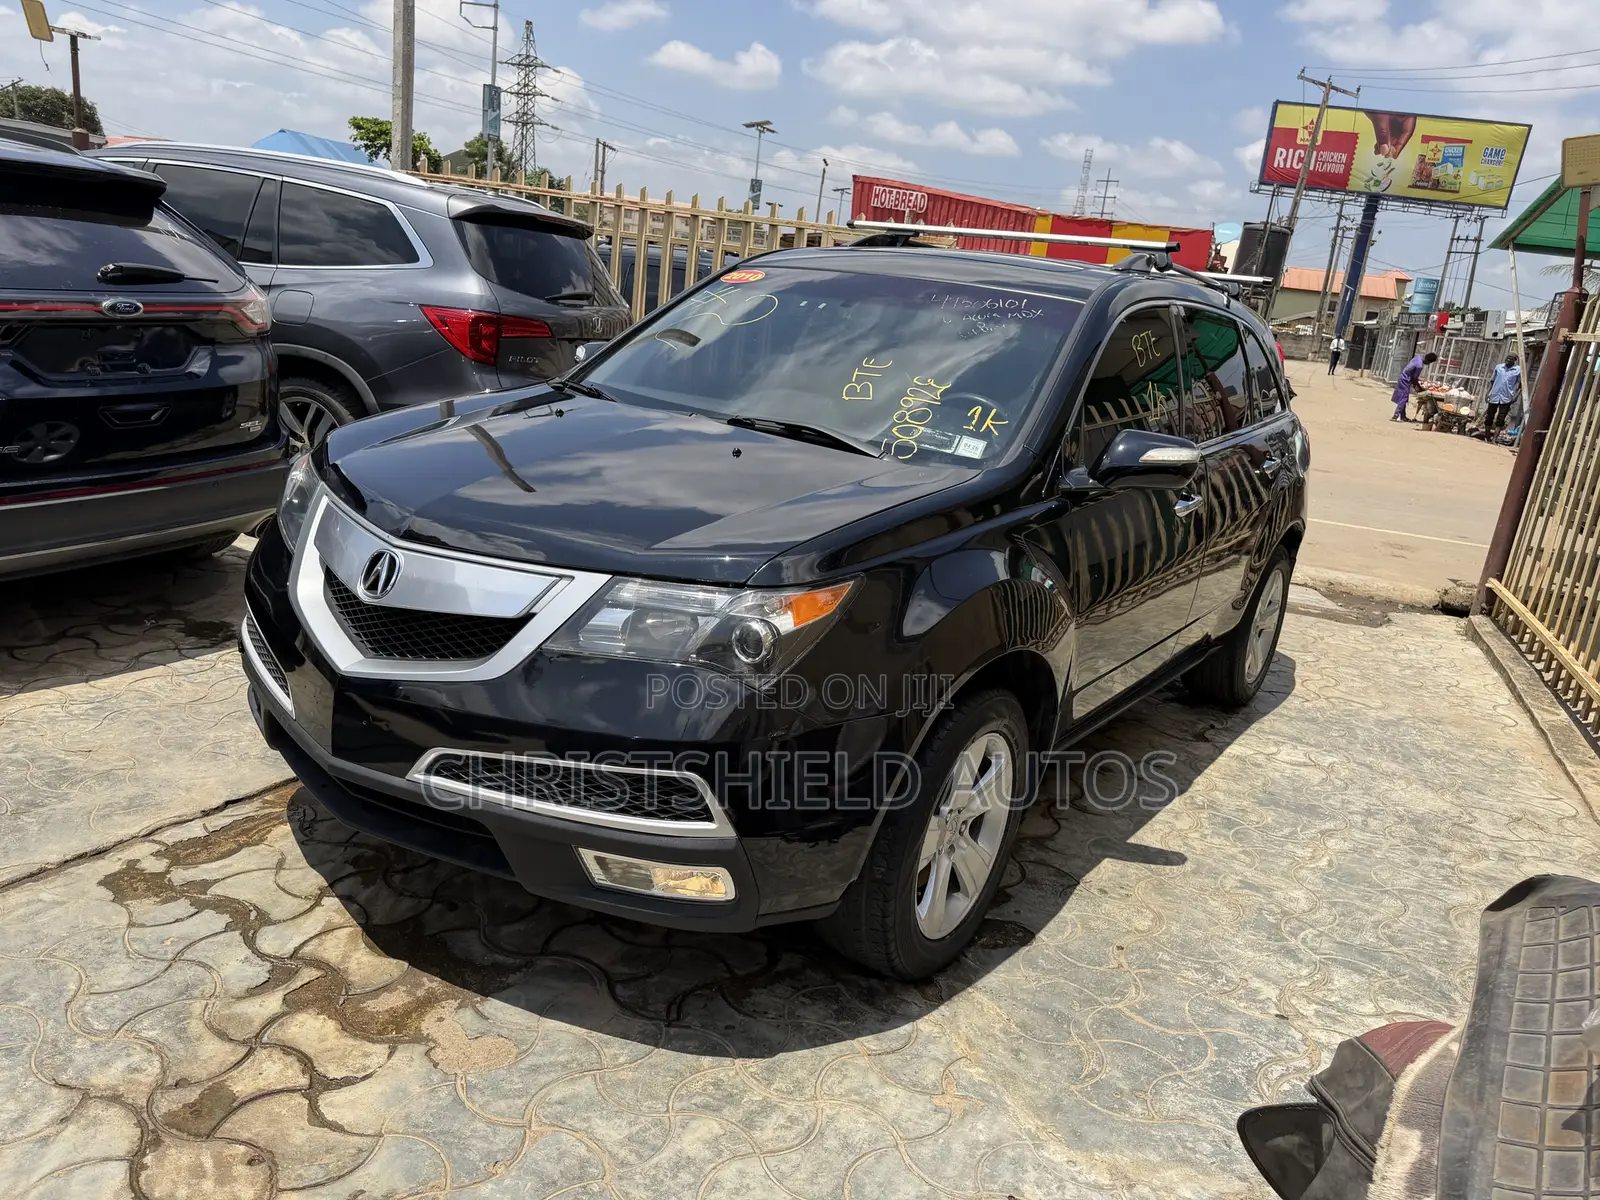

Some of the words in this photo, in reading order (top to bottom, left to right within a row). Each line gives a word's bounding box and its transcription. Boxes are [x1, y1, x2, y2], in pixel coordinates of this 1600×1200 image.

[1318, 151, 1348, 164] CHICKEN
[1315, 161, 1345, 174] FLAVOUR
[722, 271, 764, 282] 2010
[116, 302, 136, 313] Ford
